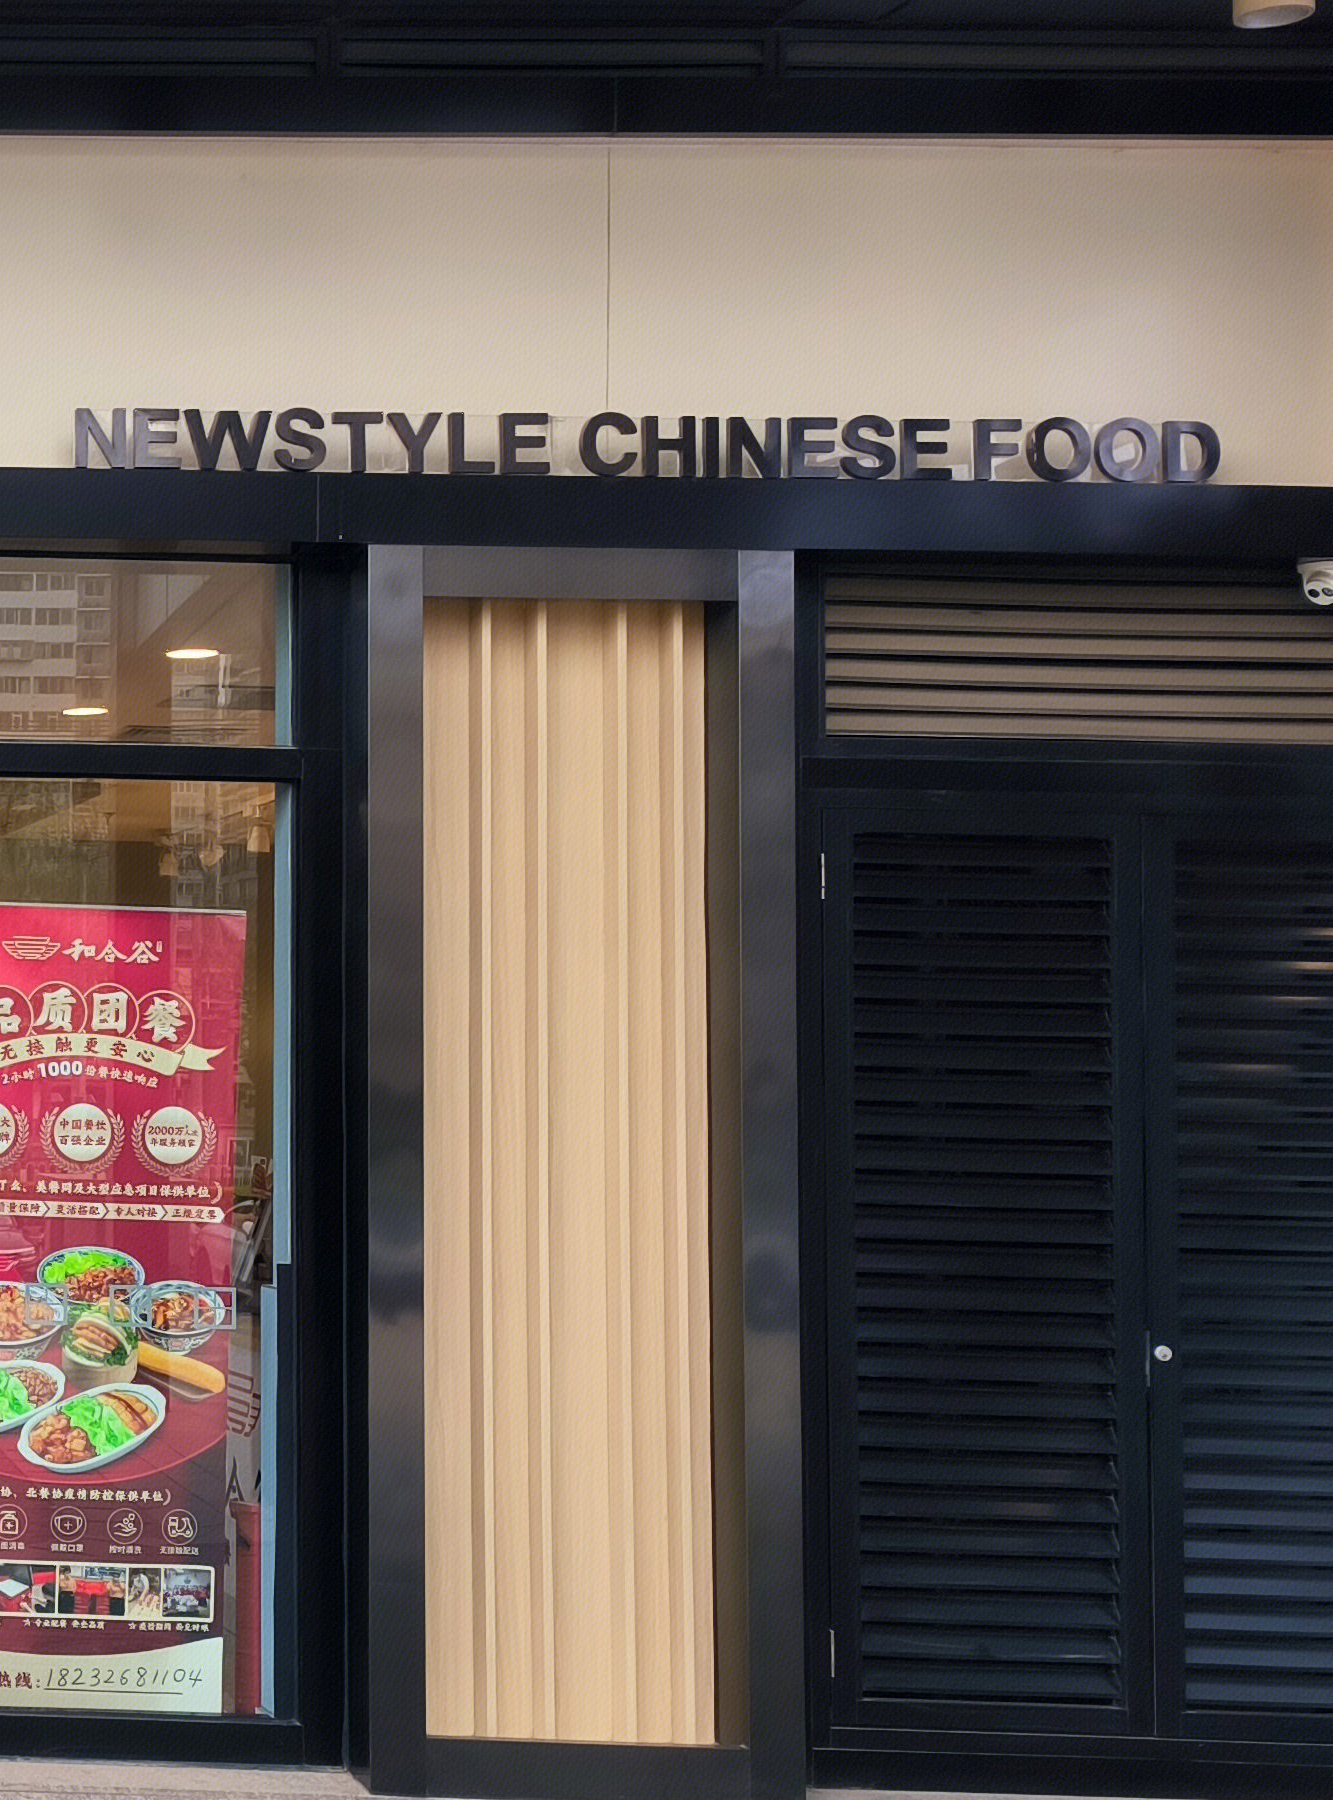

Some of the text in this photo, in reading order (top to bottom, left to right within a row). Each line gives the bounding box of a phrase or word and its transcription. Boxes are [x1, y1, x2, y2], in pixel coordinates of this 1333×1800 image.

[73, 406, 1222, 483] NEWSTYLE CHINESE FOOD
[61, 938, 161, 964] 和合谷
[0, 1036, 155, 1063] 无接触更安心
[58, 1134, 108, 1147] 百强企业
[47, 1667, 203, 1689] 18232681104
